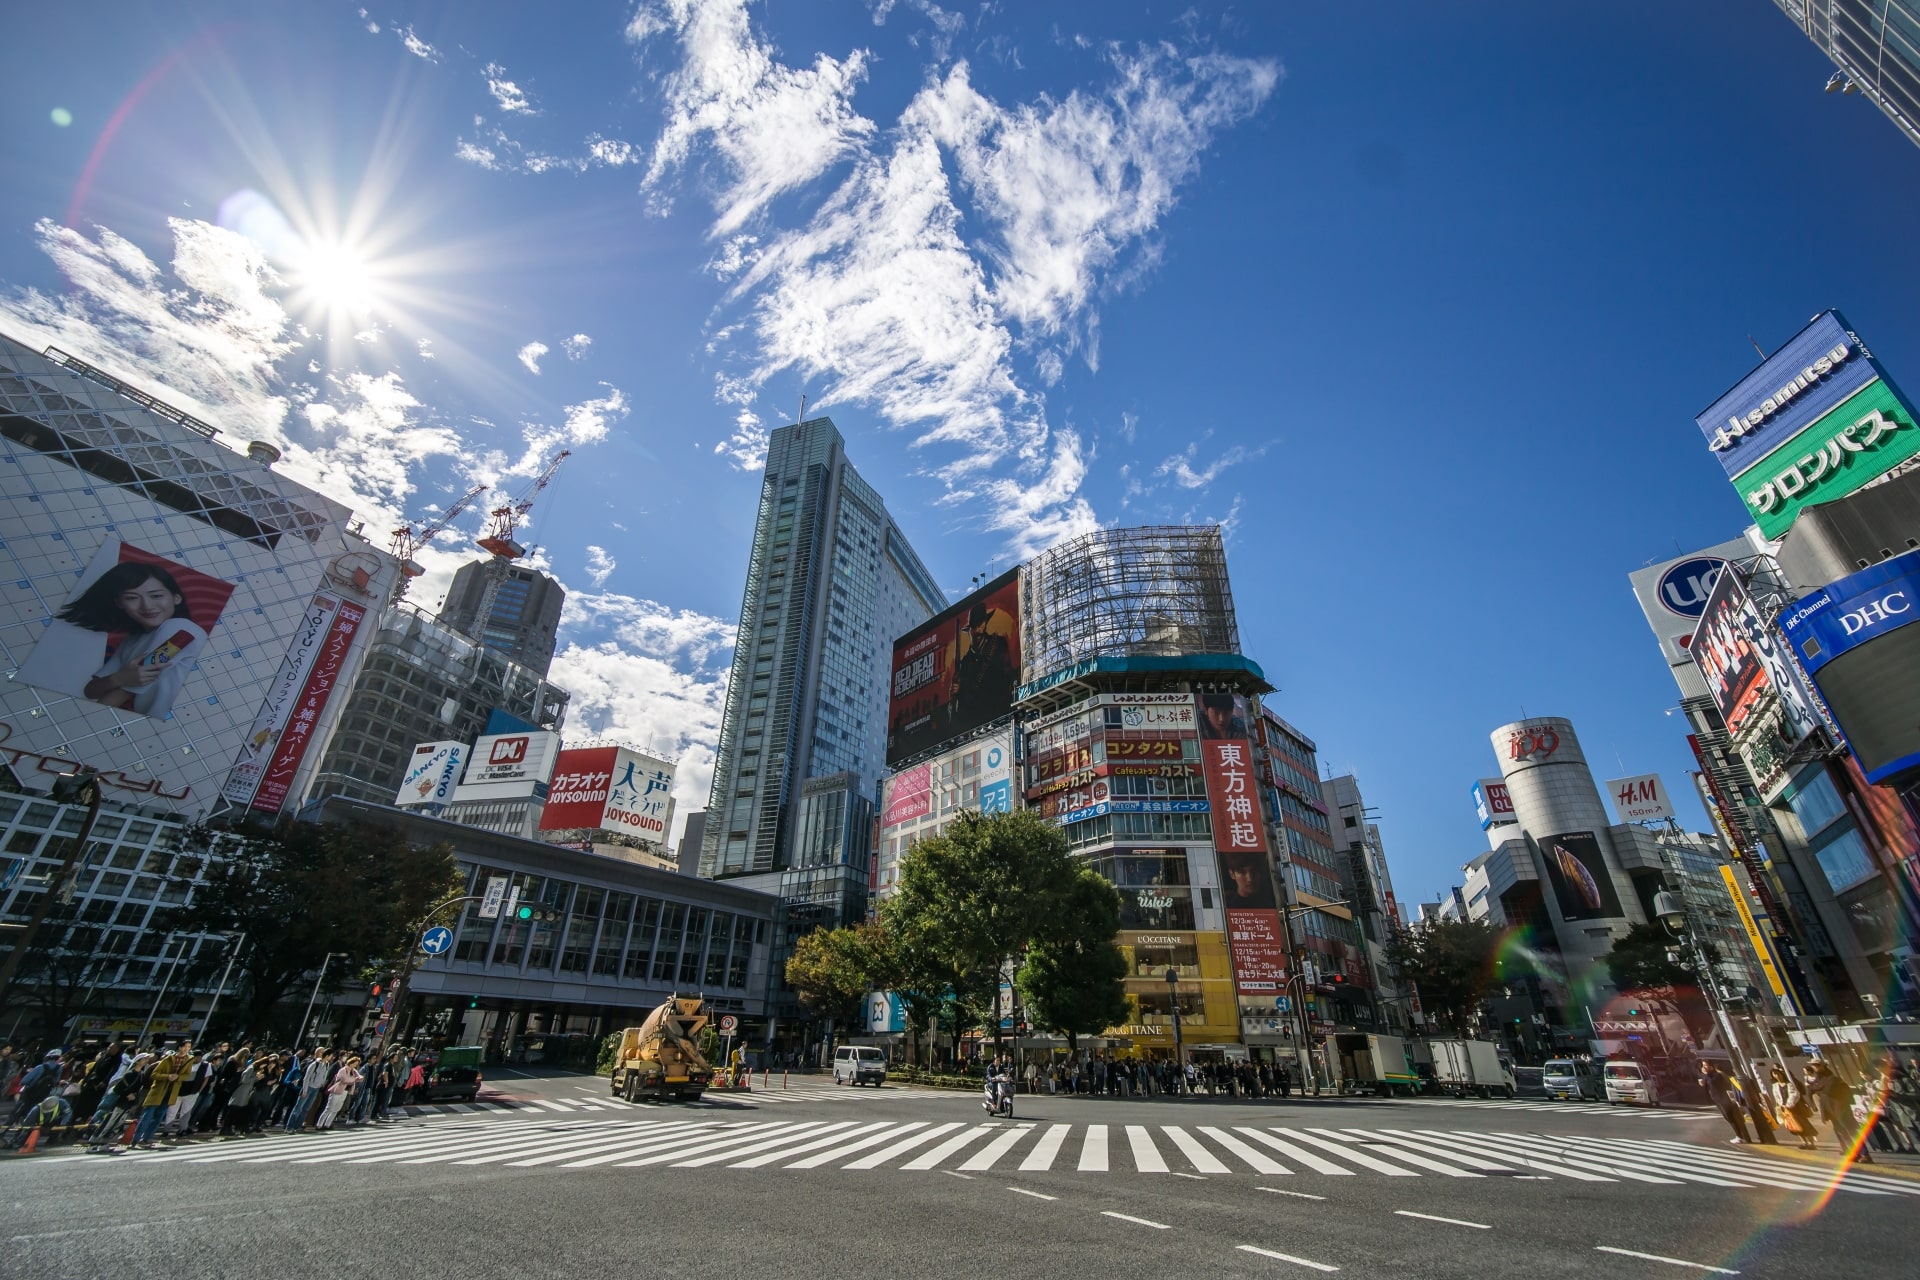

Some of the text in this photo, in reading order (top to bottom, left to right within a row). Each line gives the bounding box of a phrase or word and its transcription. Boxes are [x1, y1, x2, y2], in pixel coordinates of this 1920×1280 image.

[1709, 342, 1849, 452] Hisamitsu
[1747, 408, 1898, 514] サロンパス
[1785, 594, 1832, 631] DHC Channel
[1838, 591, 1911, 636] DHC
[894, 666, 935, 697] REDEMPTION
[895, 665, 911, 685] RED
[912, 652, 935, 676] DEAD
[1146, 708, 1193, 722] しゃぶ葉
[1510, 725, 1555, 738] SHIBUYA
[1107, 741, 1179, 755] コンタクト
[1508, 731, 1560, 760] 109
[404, 749, 448, 785] SANKYO
[437, 746, 460, 797] SANKYO
[489, 771, 526, 780] MasterCard
[613, 761, 672, 796] 大声
[983, 767, 1006, 780] eyecity
[1070, 770, 1096, 788] ガスト
[1160, 764, 1195, 777] ガスト
[552, 771, 610, 791] カラオケ
[1618, 779, 1658, 807] H&M
[548, 789, 607, 804] JOYSOUND
[609, 788, 666, 818] だそうぜ
[1057, 791, 1090, 813] ガスト
[1142, 801, 1209, 812] 英会話イーオン
[1217, 743, 1259, 848] 東方神起
[604, 807, 663, 833] JOYSOUND
[1628, 807, 1654, 817] 150m
[1232, 931, 1274, 941] 東京ドーム
